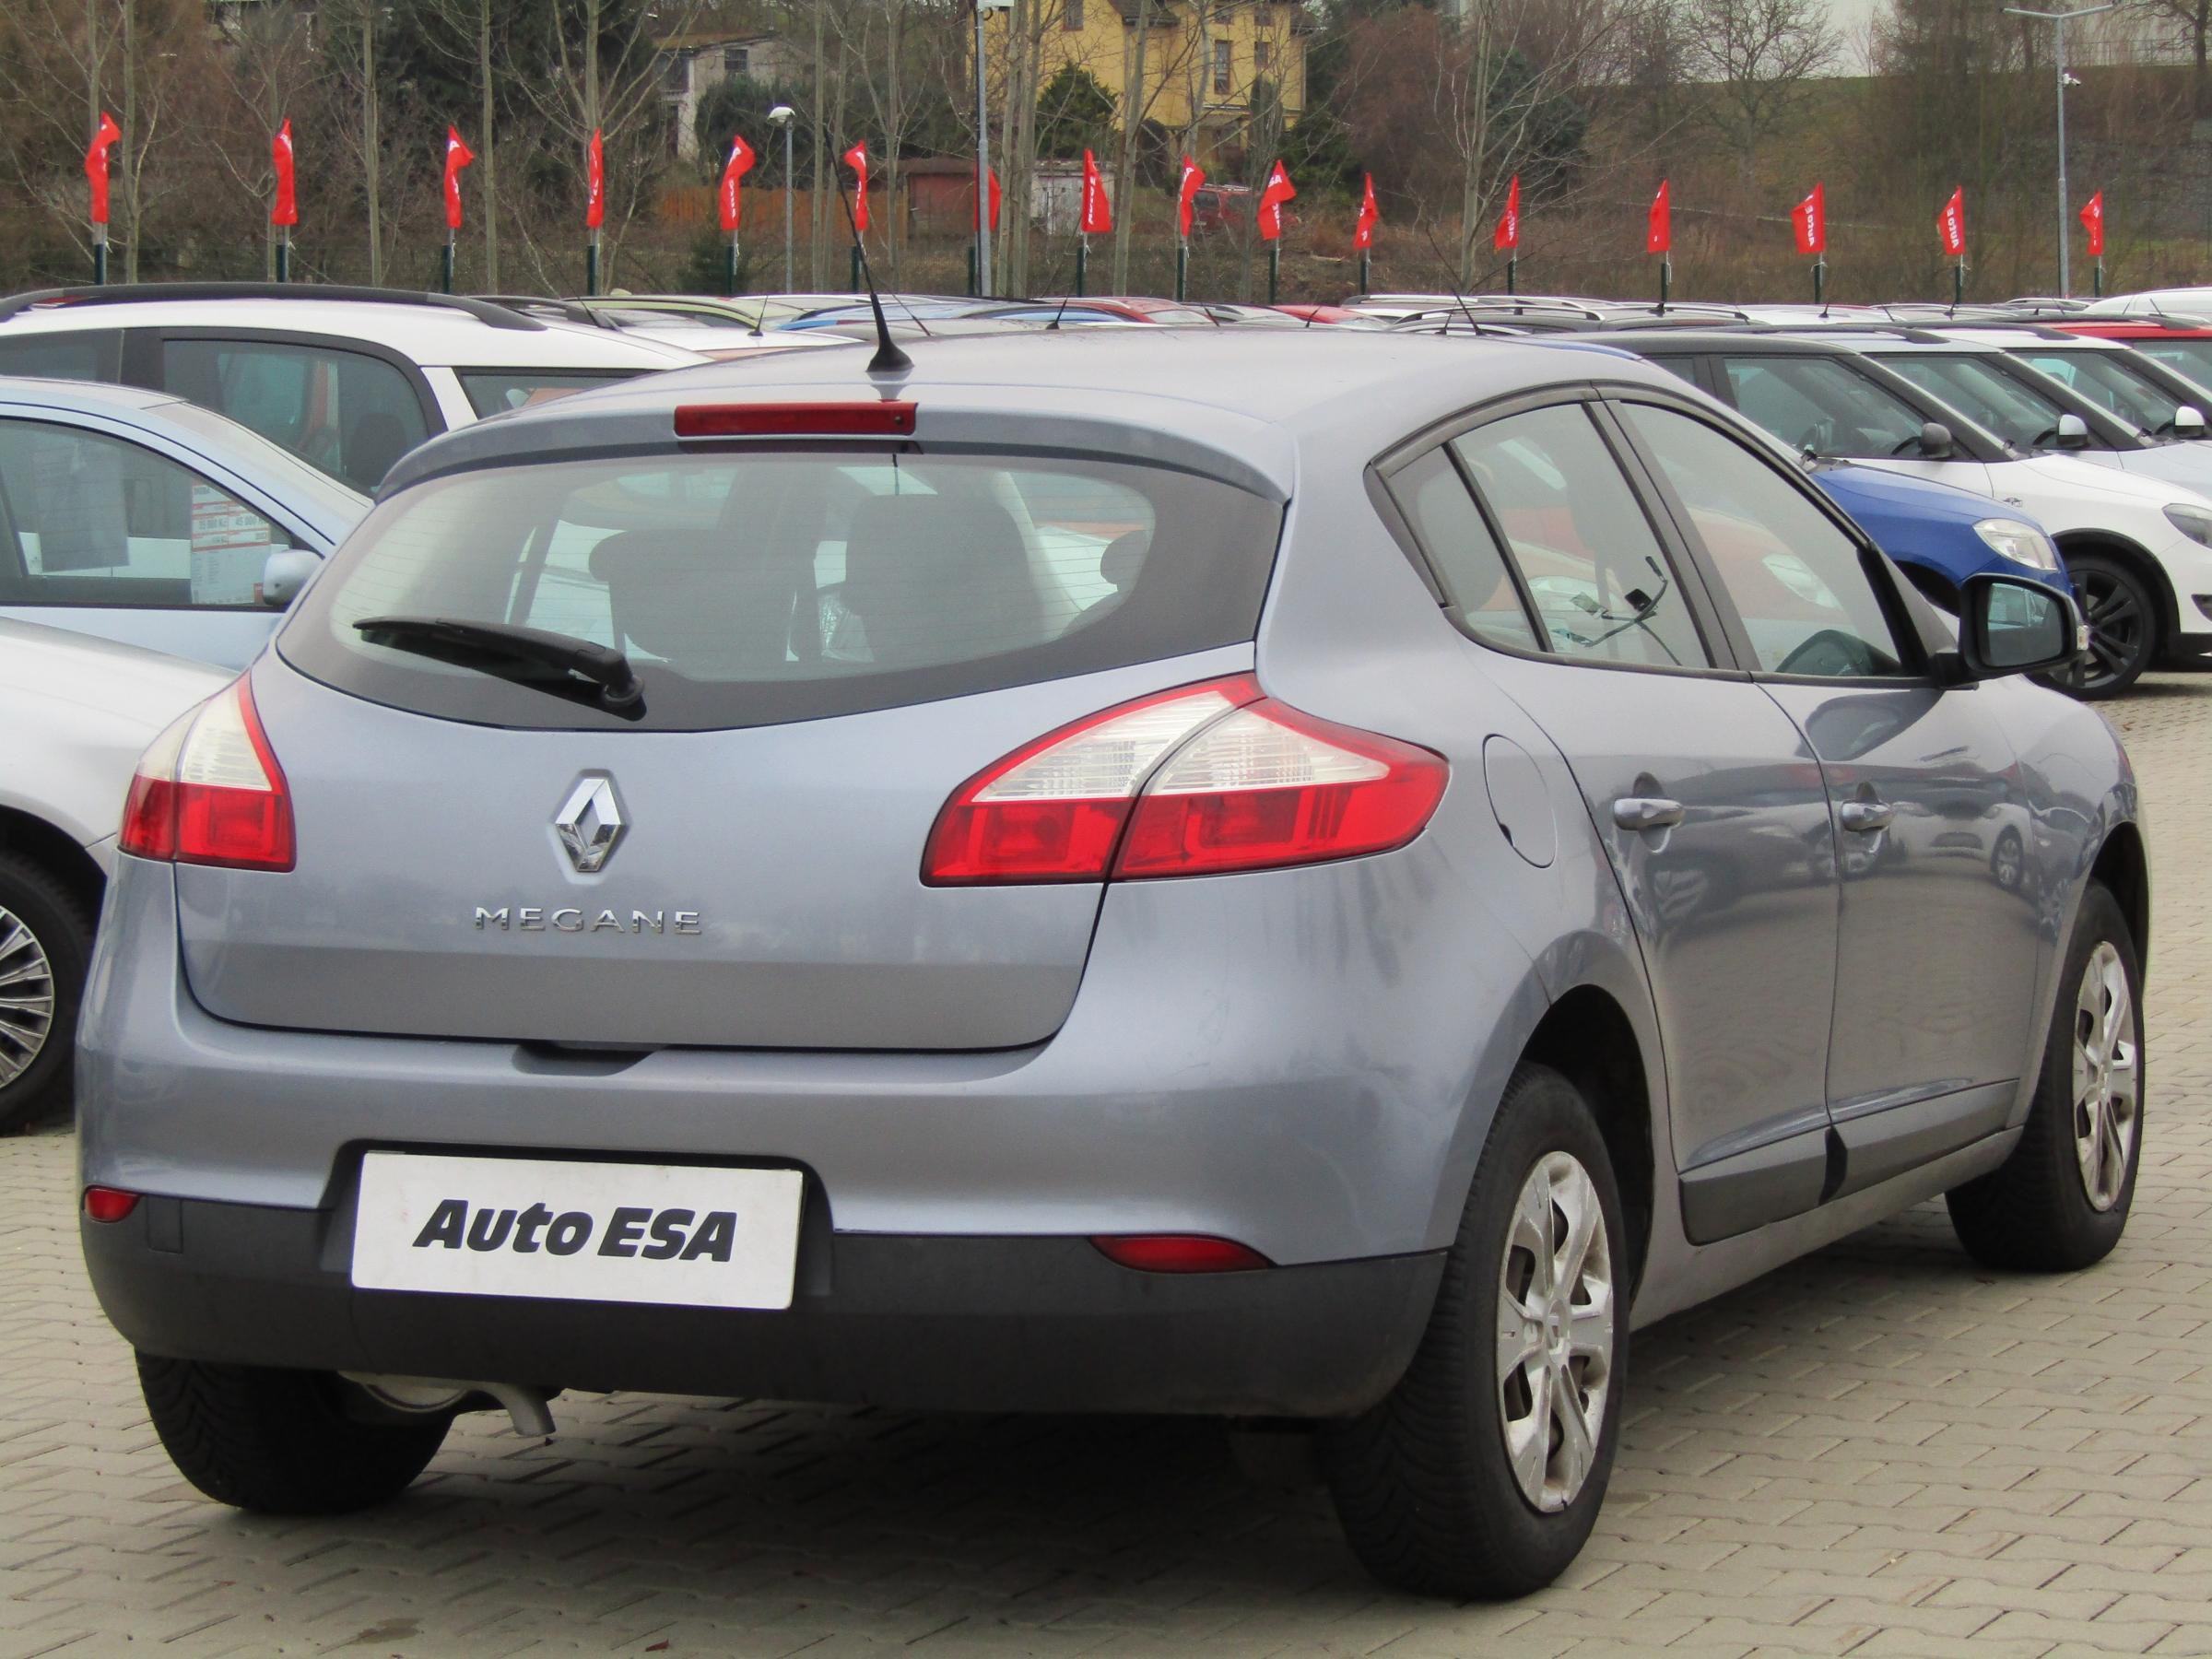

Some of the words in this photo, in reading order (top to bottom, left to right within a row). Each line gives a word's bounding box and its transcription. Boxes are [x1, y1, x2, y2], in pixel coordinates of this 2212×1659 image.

[474, 906, 701, 935] MEGANE
[412, 1199, 593, 1256] Auto
[597, 1206, 737, 1262] ESA
